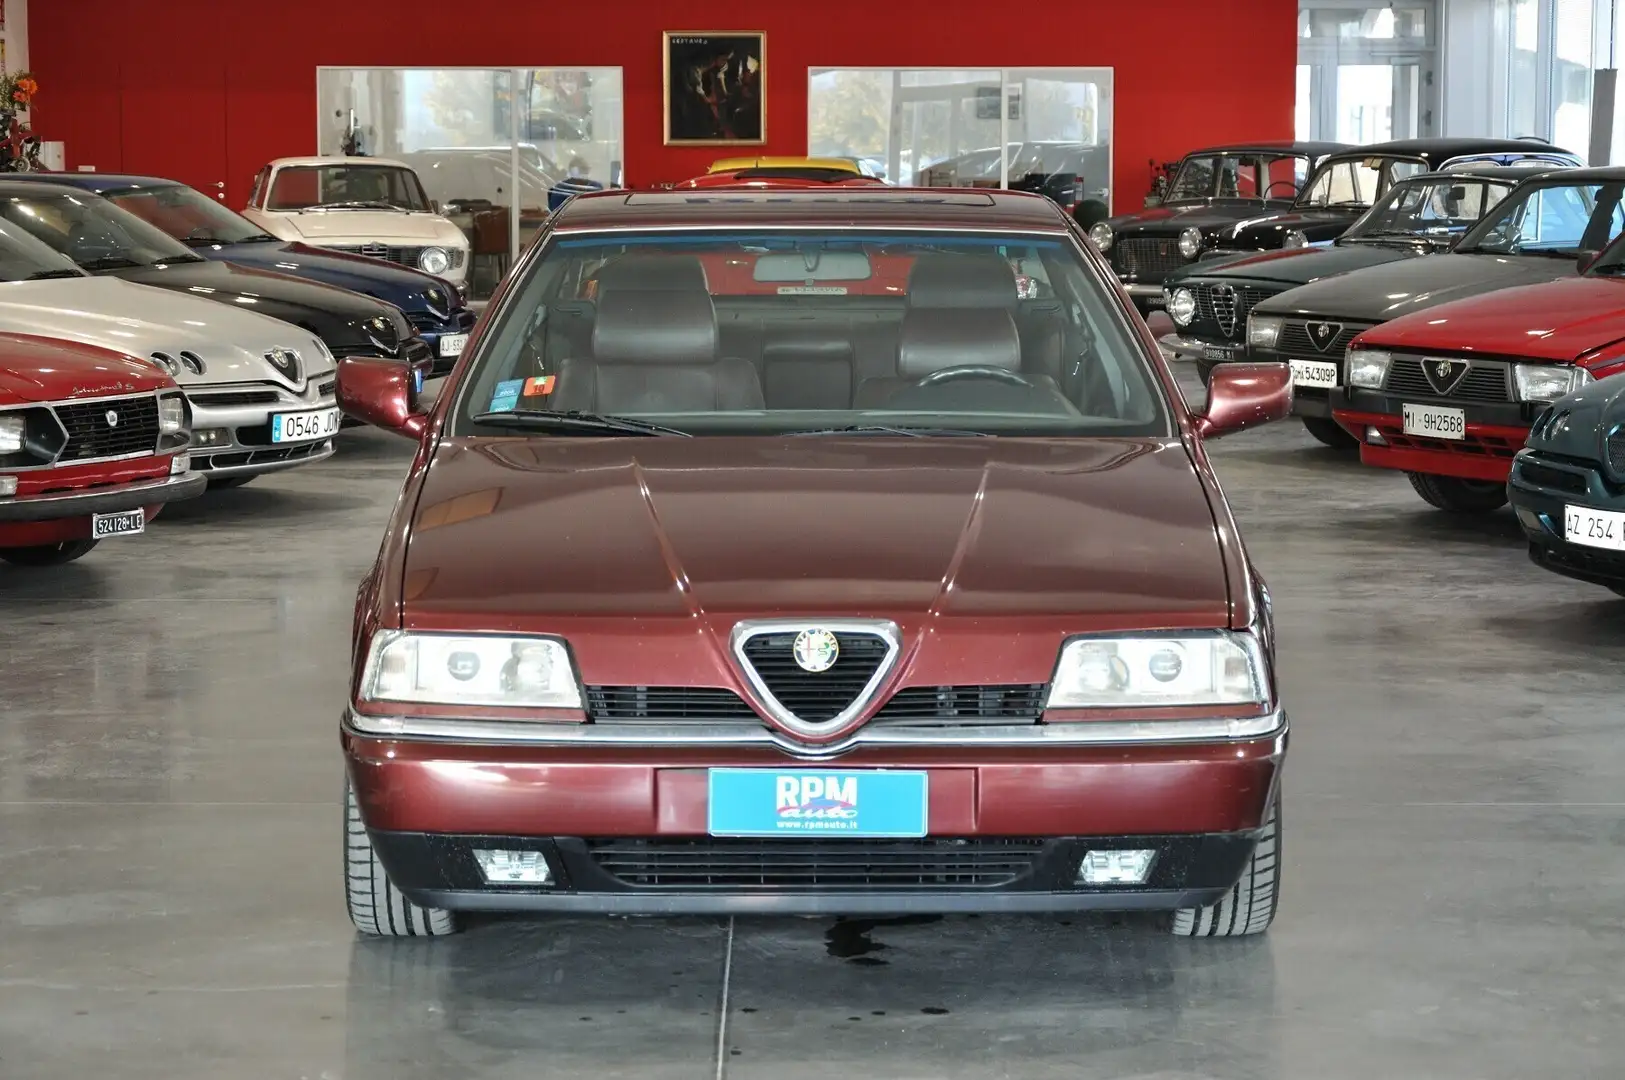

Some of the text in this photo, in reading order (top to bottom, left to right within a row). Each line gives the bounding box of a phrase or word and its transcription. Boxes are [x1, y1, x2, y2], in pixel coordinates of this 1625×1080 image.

[1305, 366, 1336, 382] 54309P
[286, 415, 320, 437] 0546
[1404, 411, 1463, 433] MI 9H2568
[98, 516, 127, 533] 524128
[1566, 513, 1580, 535] AZ
[1588, 517, 1613, 539] 254
[776, 776, 858, 808] RPM
[776, 820, 858, 830] www.rpmauto.it
